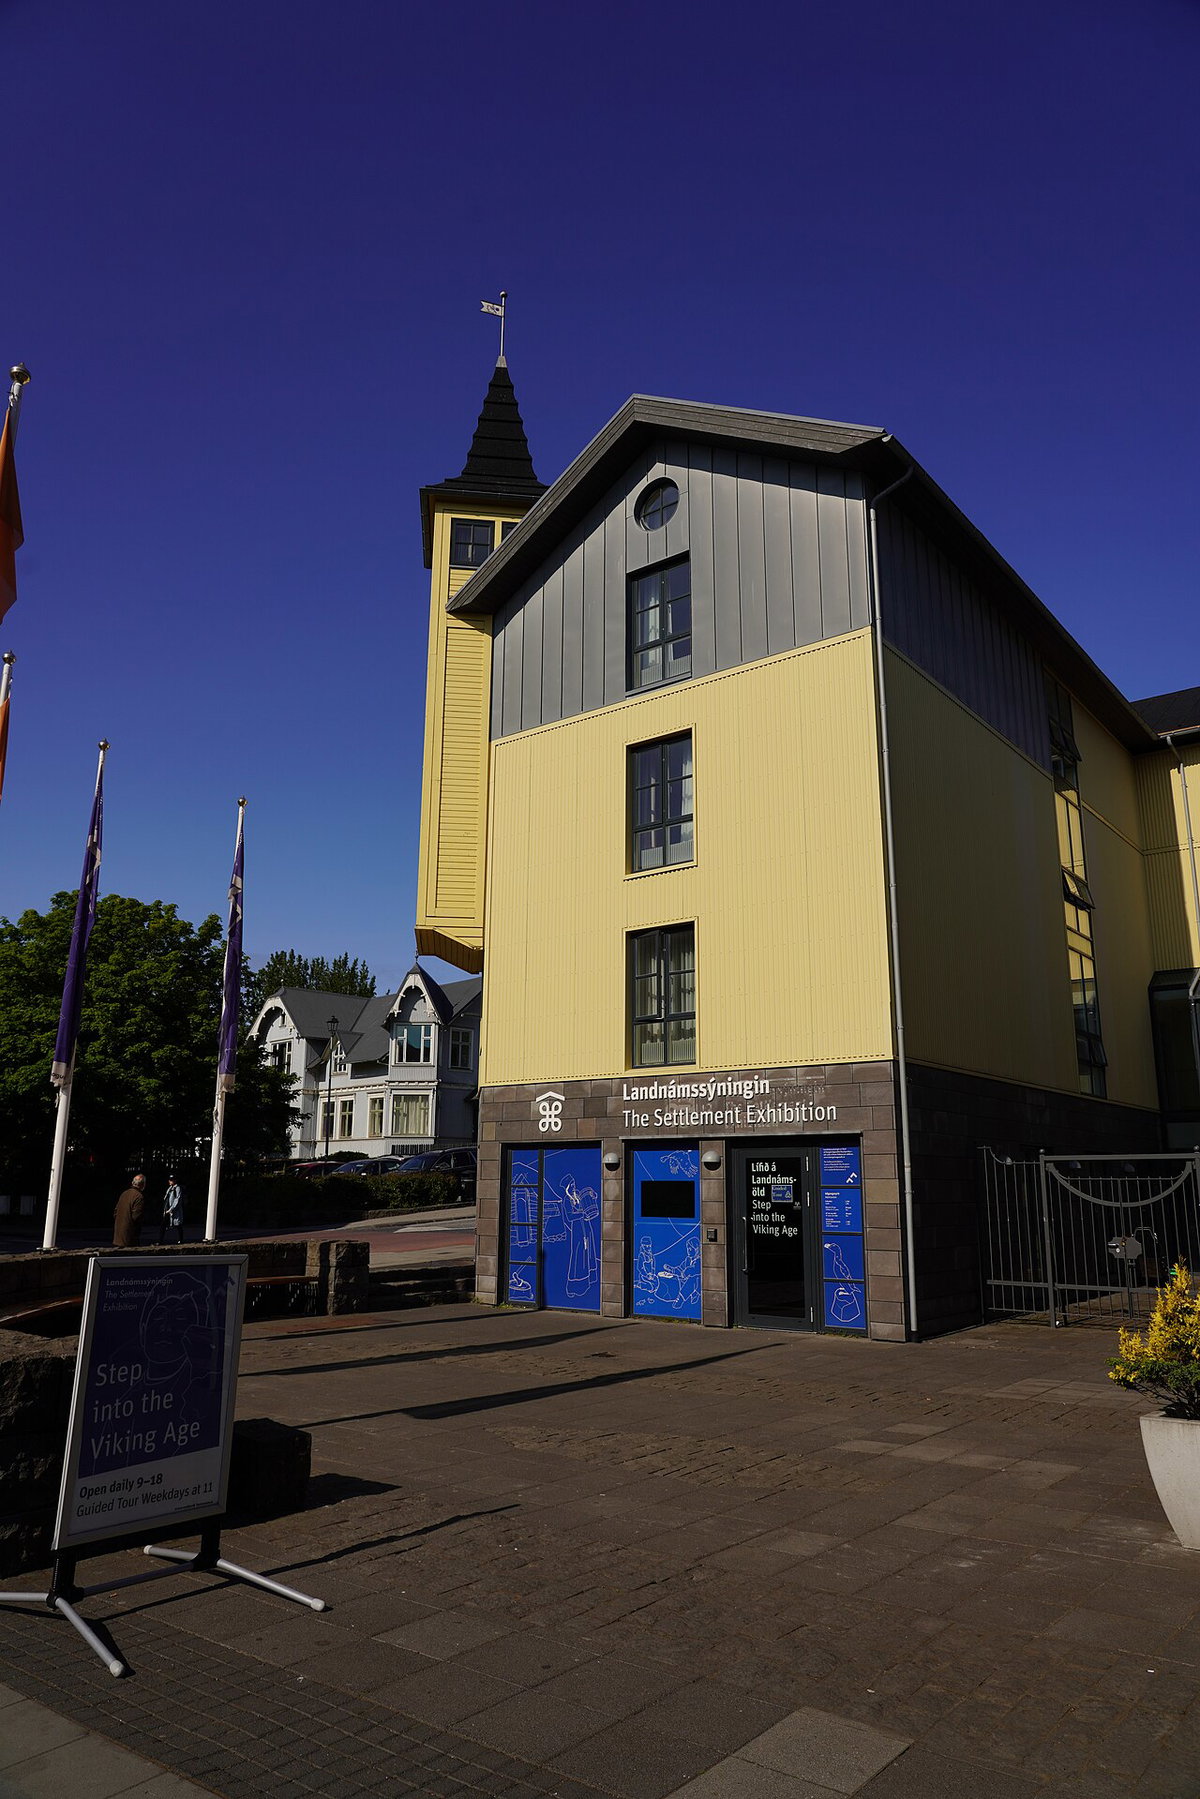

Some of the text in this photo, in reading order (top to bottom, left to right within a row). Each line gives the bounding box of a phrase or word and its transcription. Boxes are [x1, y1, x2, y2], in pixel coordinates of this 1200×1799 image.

[623, 1075, 770, 1101] Landnámssýningin
[623, 1102, 837, 1128] The Settlement Exhibition
[751, 1161, 777, 1172] Lífið á
[752, 1174, 797, 1185] Landnáms-
[752, 1186, 766, 1197] öld
[752, 1199, 772, 1211] Step
[752, 1212, 786, 1222] into the
[752, 1224, 798, 1237] Viking Age
[95, 1363, 143, 1387] Step
[93, 1389, 174, 1423] into the
[91, 1420, 201, 1460] Viking Age
[79, 1484, 107, 1499] Open
[110, 1478, 135, 1492] daily
[76, 1482, 213, 1518] Guided Tour Weekdays at 11
